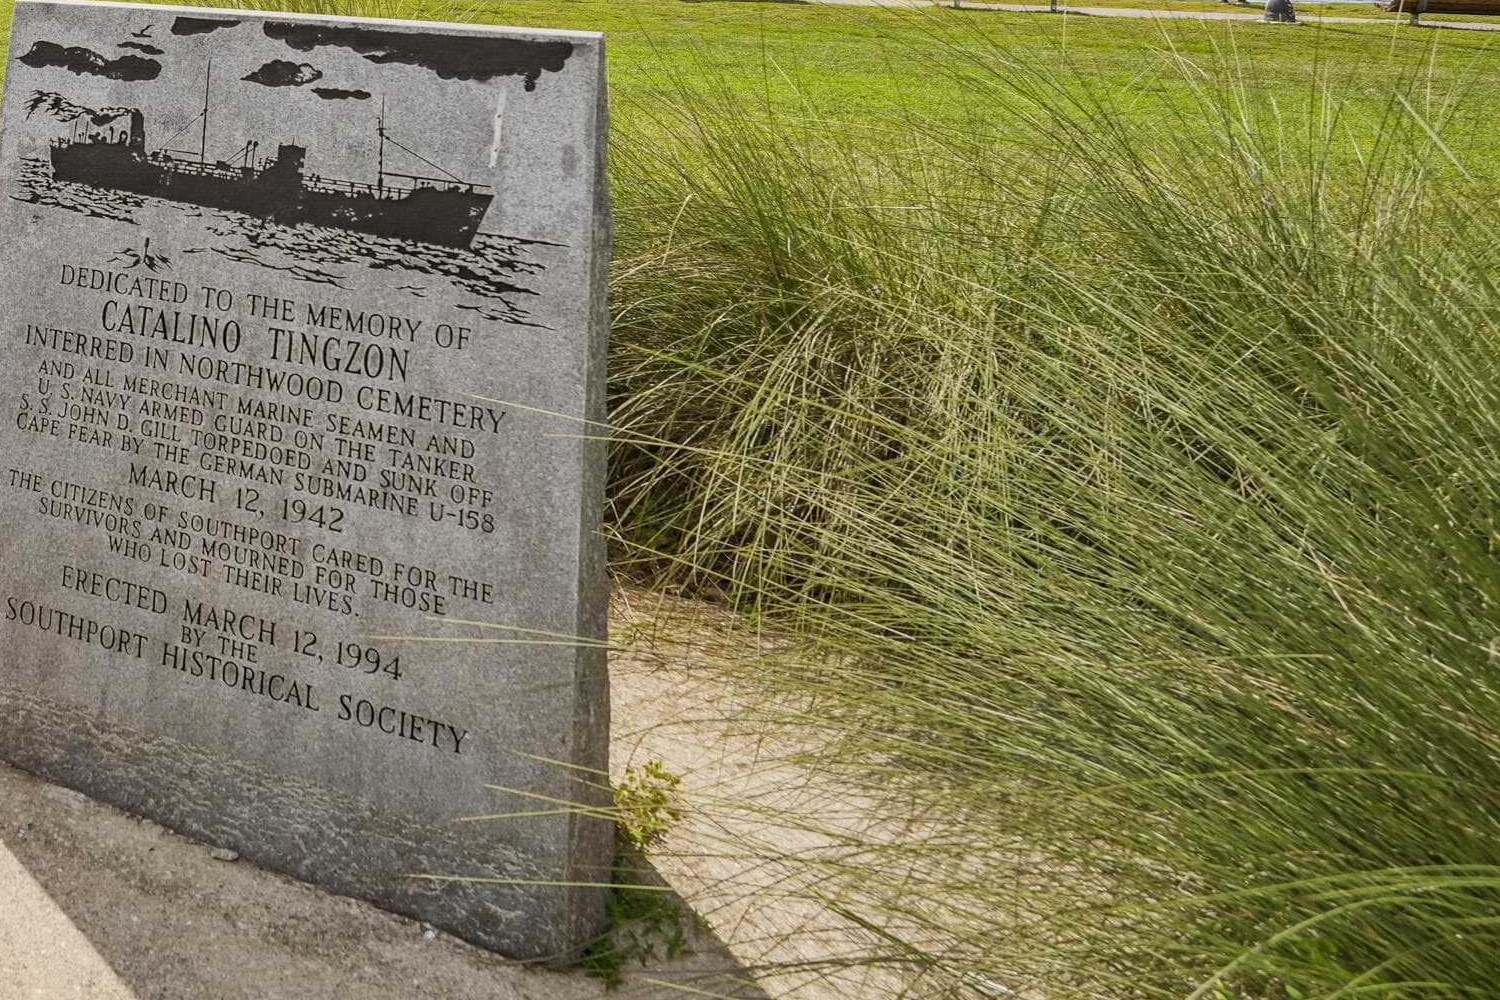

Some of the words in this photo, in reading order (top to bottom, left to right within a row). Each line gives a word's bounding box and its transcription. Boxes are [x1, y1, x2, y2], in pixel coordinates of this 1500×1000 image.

[60, 264, 188, 303] DEDICATED
[202, 286, 232, 311] TO
[247, 294, 295, 322] THE
[307, 304, 422, 342] MEMORY
[435, 324, 471, 350] OF
[102, 300, 241, 353] CATALINO
[268, 327, 410, 382] TINGZON
[26, 324, 133, 363] INTERRED
[145, 346, 169, 371] IN
[179, 353, 343, 403] NORTHWOOD
[357, 386, 506, 434] CEMETERY
[38, 378, 52, 396] U.
[60, 382, 74, 400] S.
[81, 387, 131, 410] NAVY
[139, 400, 203, 425] ARMED
[214, 415, 282, 442] GUARD
[294, 431, 324, 451] ON
[335, 438, 375, 462] THE
[389, 449, 475, 483] TANKER
[39, 360, 74, 379] AND
[83, 368, 113, 387] ALL
[123, 375, 228, 410] MERCHANT
[237, 397, 313, 427] MARINE
[326, 414, 415, 447] SEAMEN
[425, 435, 475, 459] AND
[17, 412, 60, 436] CAPE
[68, 424, 112, 447] FEAR
[121, 435, 144, 454] BY
[154, 442, 189, 465] THE
[200, 452, 283, 485] GERMAN
[294, 473, 418, 516] SUBMARINE
[430, 502, 495, 533] U-158
[20, 393, 33, 411] S.
[38, 397, 52, 415] S.
[58, 402, 109, 426] JOHN
[117, 413, 132, 433] D.
[141, 420, 181, 442] GILL
[191, 429, 310, 469] TORPEDOED
[322, 459, 366, 482] AND
[380, 469, 437, 497] SUNK
[451, 485, 493, 508] OFF
[129, 463, 216, 503] MARCH
[237, 488, 264, 517] 12,
[282, 499, 344, 533] 1942
[10, 469, 42, 492] THE
[51, 480, 134, 516] CITIZENS
[144, 503, 168, 522] OF
[178, 511, 301, 555] SOUTHPORT
[313, 544, 383, 576] CARED
[394, 563, 437, 591] FOR
[449, 576, 493, 604] THE
[39, 497, 141, 539] SURVIVORS
[149, 527, 191, 550] AND
[202, 538, 304, 579] MOURNED
[316, 566, 355, 593] FOR
[371, 579, 445, 615] THOSE
[109, 535, 151, 562] WHO
[160, 548, 211, 577] LOST
[223, 565, 282, 596] THEIR
[294, 583, 358, 617] LIVES.
[6, 597, 148, 658] SOUTHPORT
[162, 642, 319, 711] HISTORICAL
[338, 695, 467, 754] SOCIETY
[62, 565, 167, 614] ERECTED
[184, 599, 276, 646] MARCH
[294, 631, 323, 664] 12,
[337, 642, 402, 680] 1994
[181, 625, 206, 647] BY
[218, 636, 257, 663] THE
